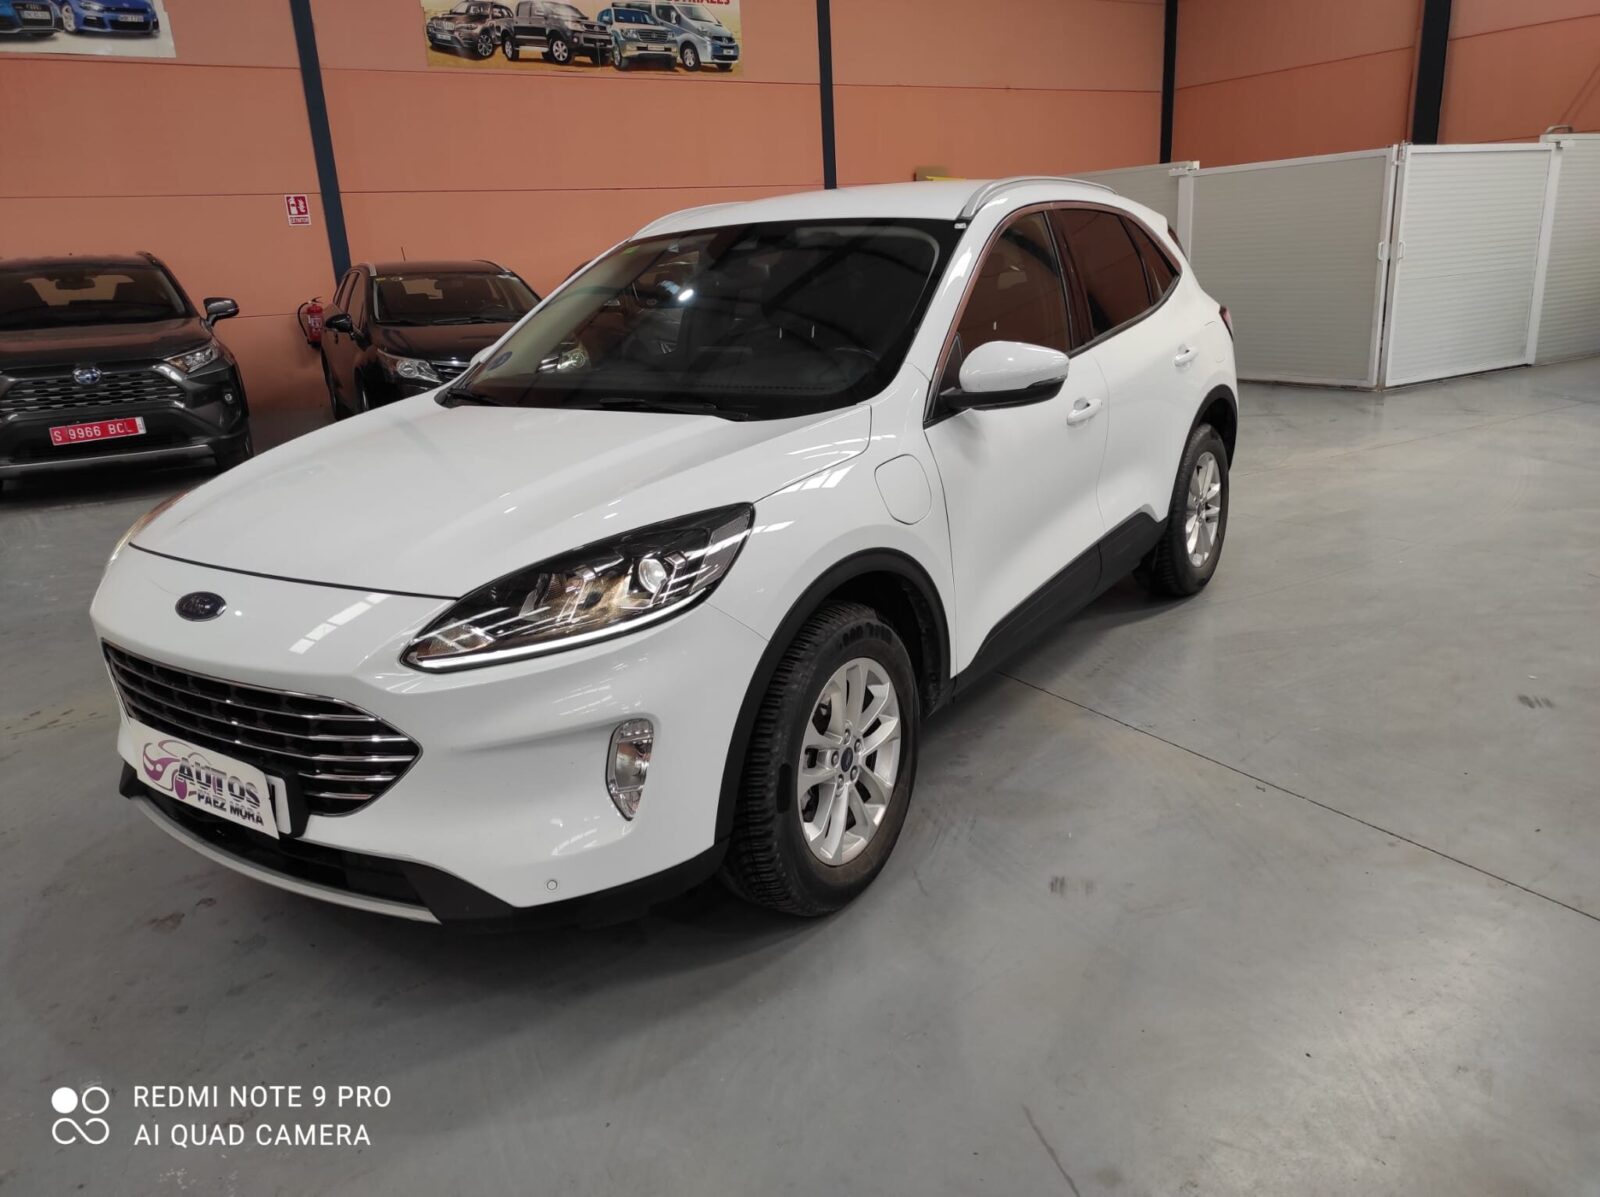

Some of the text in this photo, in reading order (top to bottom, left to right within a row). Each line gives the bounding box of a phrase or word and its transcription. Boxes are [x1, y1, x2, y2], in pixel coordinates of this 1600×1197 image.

[53, 430, 62, 441] S
[68, 426, 101, 439] 9966
[178, 757, 260, 809] AUTOS
[197, 791, 264, 826] PAEZ MORA
